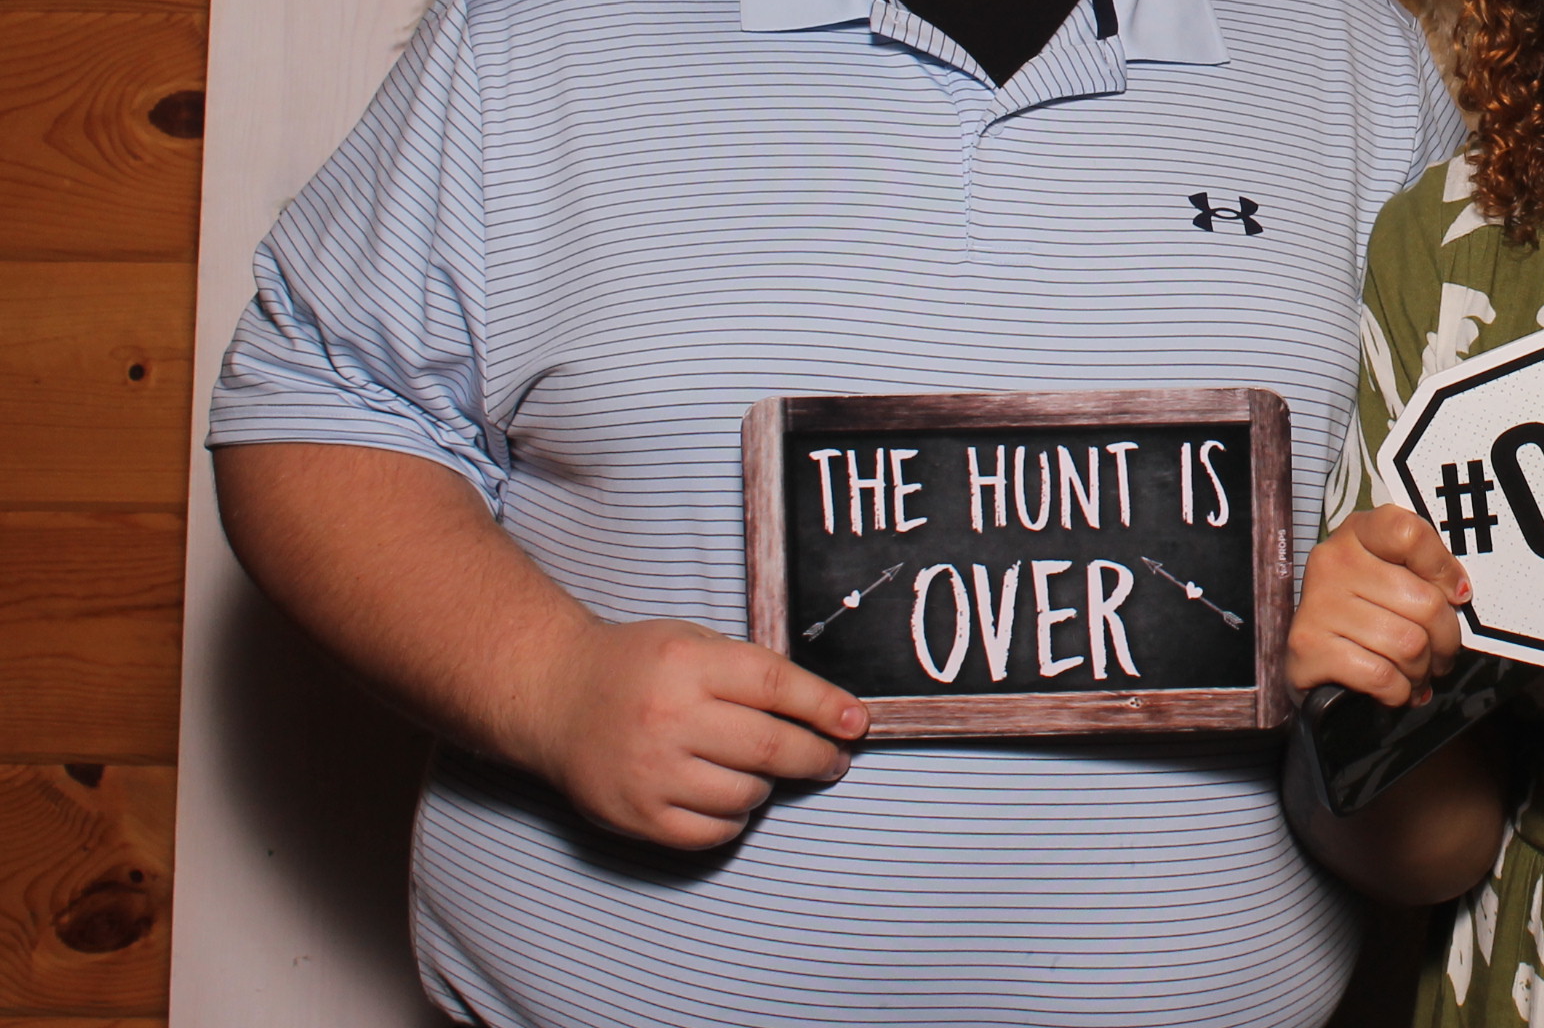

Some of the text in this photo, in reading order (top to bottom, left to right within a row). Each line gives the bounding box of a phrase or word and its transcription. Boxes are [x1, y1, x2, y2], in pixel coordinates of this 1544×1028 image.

[808, 439, 1230, 536] THE HUNT IS
[911, 559, 1141, 684] OVER
